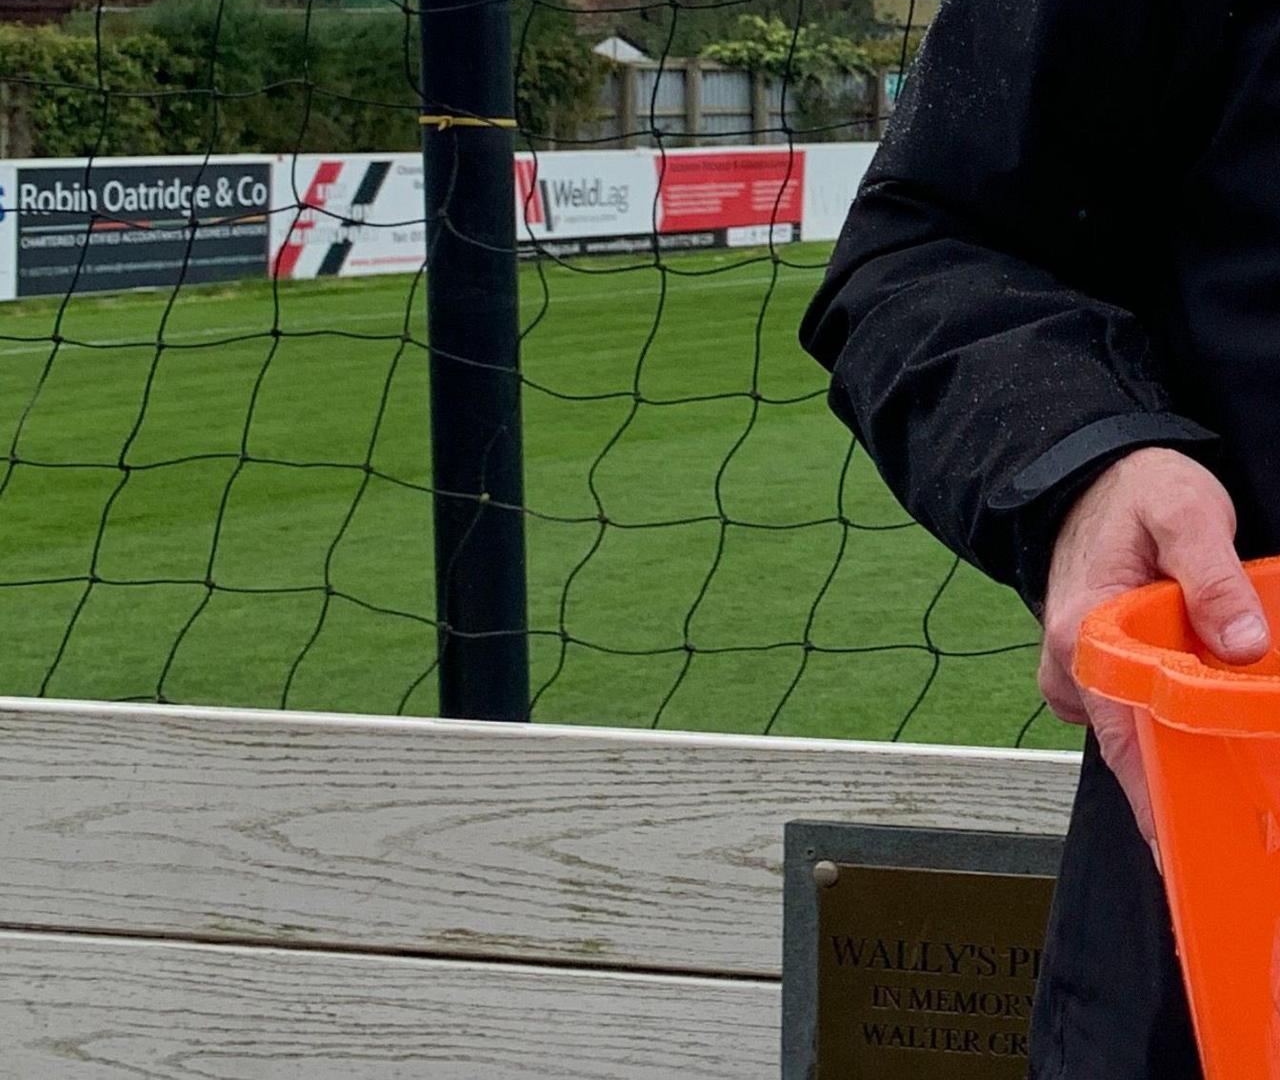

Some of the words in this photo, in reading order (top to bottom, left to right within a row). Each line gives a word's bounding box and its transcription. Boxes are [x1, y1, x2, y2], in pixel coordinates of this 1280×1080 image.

[20, 181, 97, 216] Robin
[103, 177, 210, 217] Oatridge
[215, 177, 233, 207] &
[237, 176, 267, 207] Co
[552, 179, 629, 213] WeldLag
[831, 935, 998, 977] WALLY'S
[871, 984, 900, 1009] IN
[861, 1022, 982, 1055] WALTER
